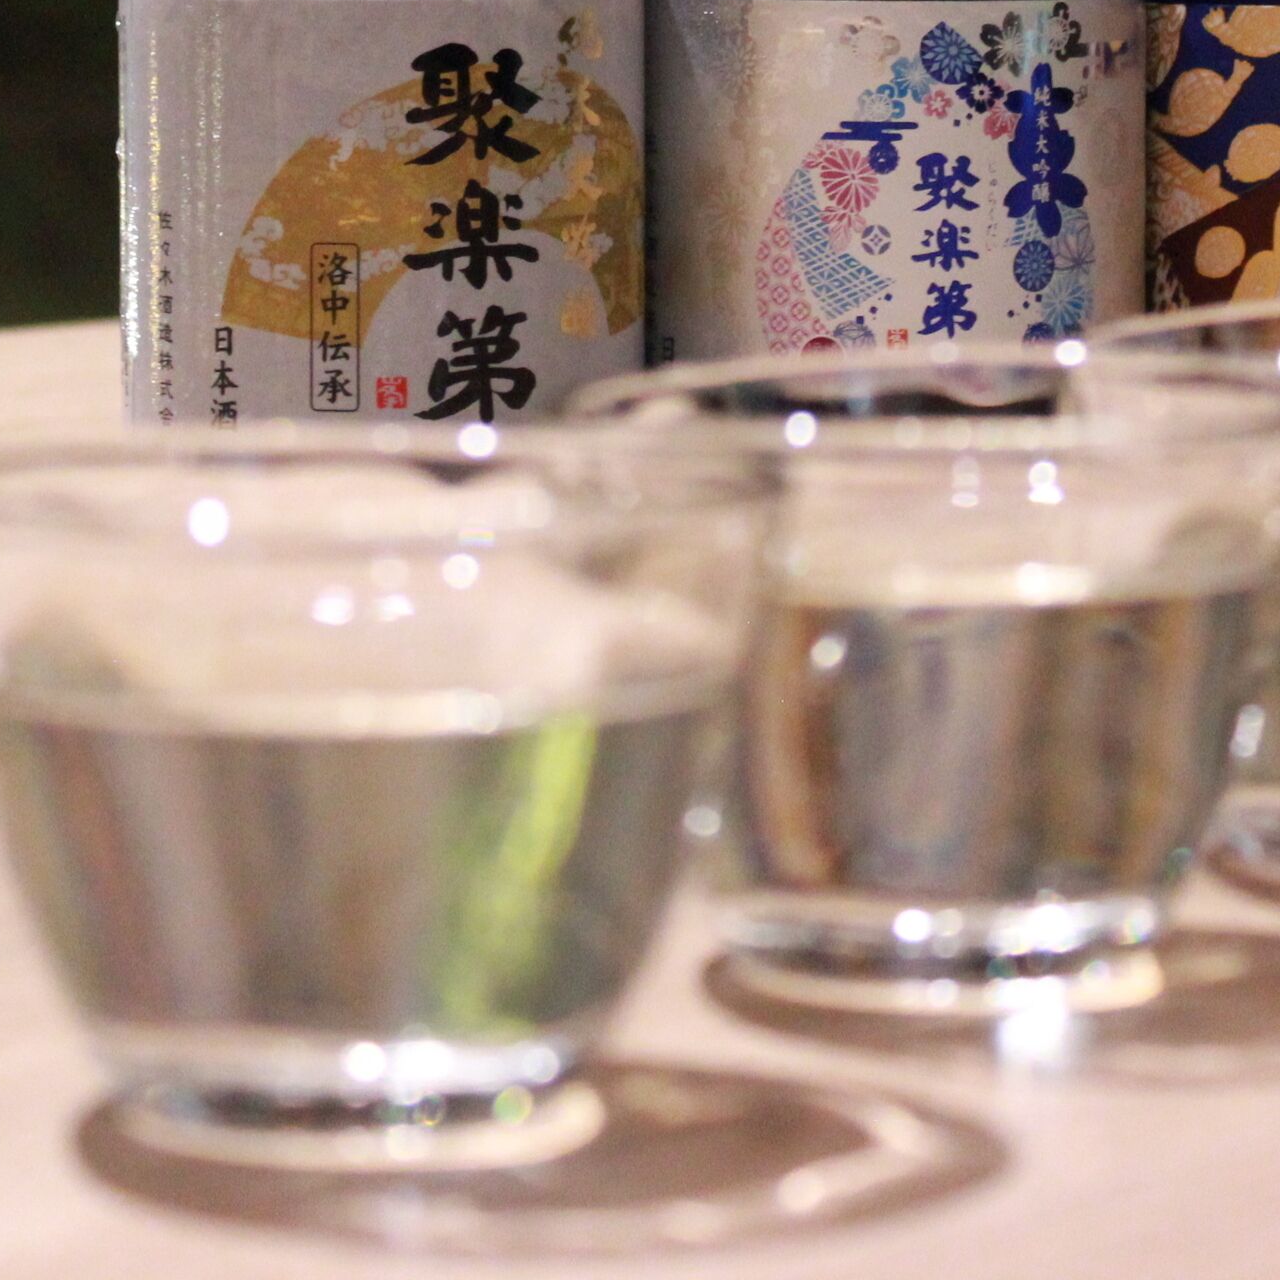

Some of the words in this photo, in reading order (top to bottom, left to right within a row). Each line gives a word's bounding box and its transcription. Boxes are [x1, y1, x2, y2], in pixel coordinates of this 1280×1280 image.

[1030, 86, 1052, 203] 純米大吟醸
[403, 41, 542, 423] 聚楽第
[910, 152, 981, 338] 聚楽第
[210, 326, 239, 430] 日本酒
[317, 251, 352, 405] 洛中伝承
